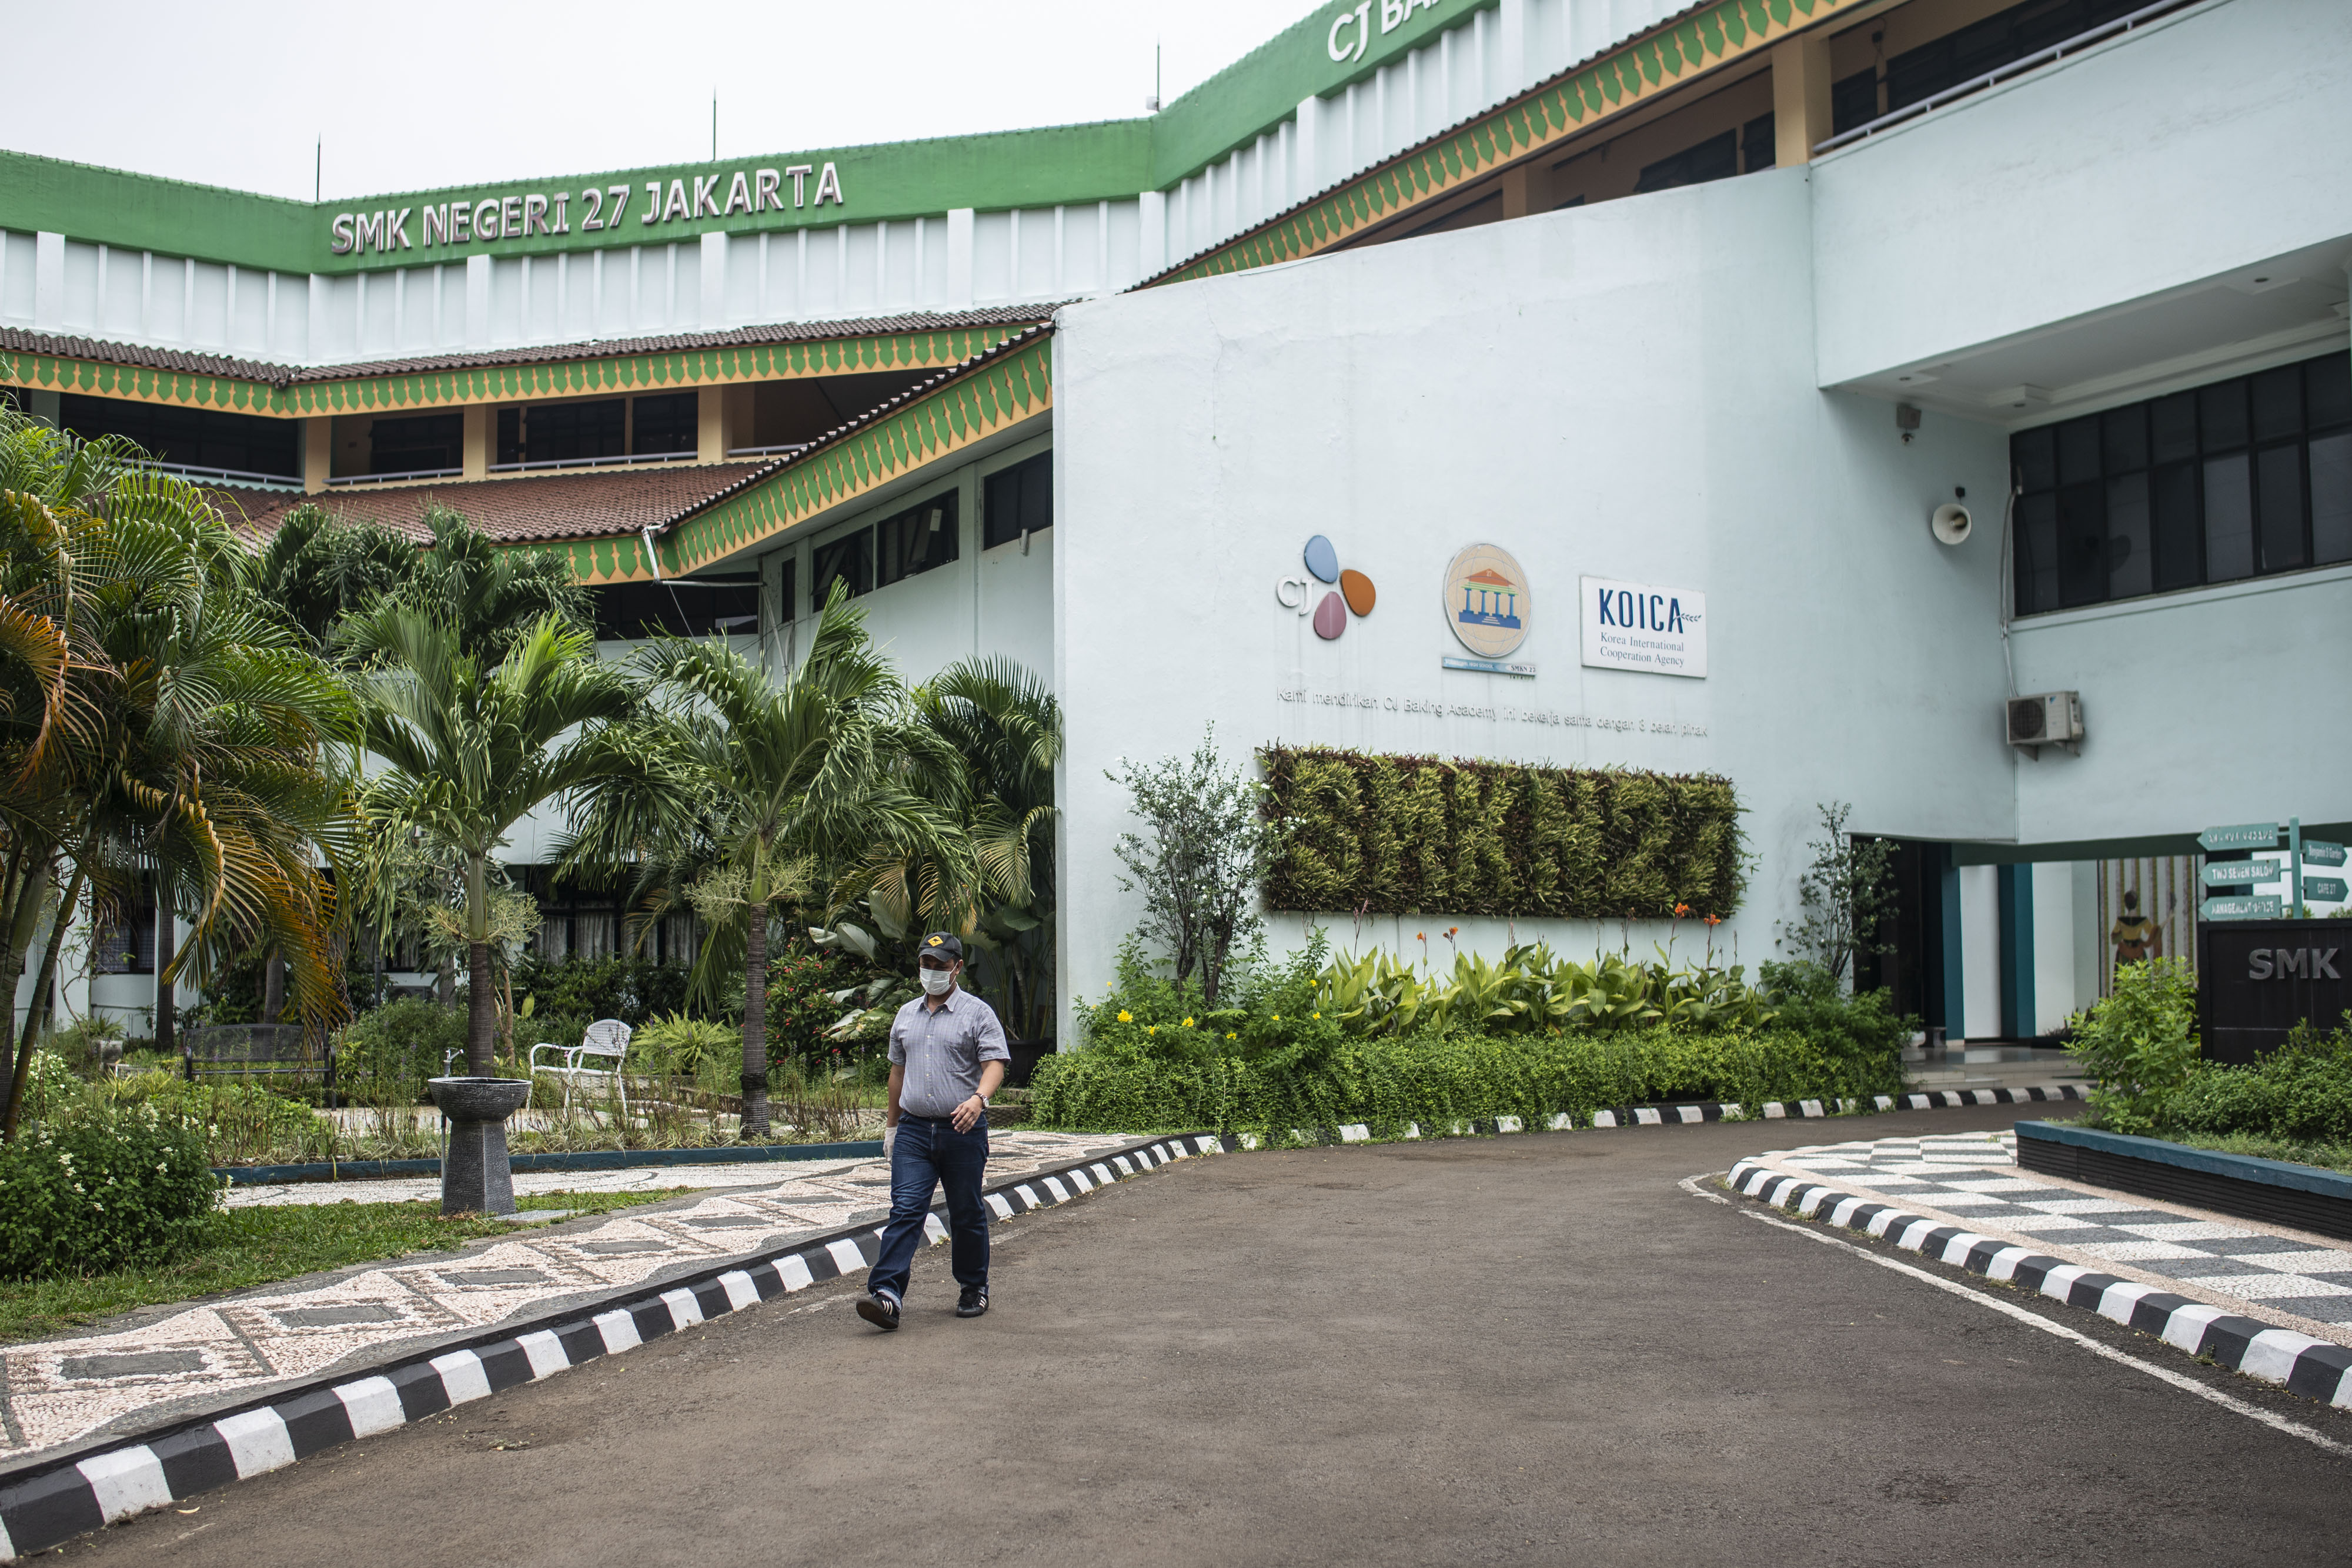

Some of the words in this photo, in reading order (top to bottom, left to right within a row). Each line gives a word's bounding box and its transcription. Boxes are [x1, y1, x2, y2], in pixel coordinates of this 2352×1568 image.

[1327, 0, 1372, 62] CJ
[1381, 0, 1441, 35] BA
[331, 207, 412, 255] SMK
[423, 192, 570, 247] NEGERI
[582, 184, 632, 230] 27
[642, 162, 844, 225] JAKARTA
[1486, 570, 1492, 578] 27
[1276, 574, 1316, 616] CJ
[1599, 587, 1684, 634] KOICA
[1600, 646, 1652, 663] Cooperation
[1654, 654, 1684, 668] Agency
[1601, 631, 1626, 645] Korea
[1630, 636, 1684, 652] International
[1277, 686, 1308, 703] Kami
[1313, 691, 1378, 709] mendirikan
[1383, 696, 1399, 710] CJ
[1404, 697, 1443, 716] Baking
[1447, 703, 1499, 721] Academy
[1521, 708, 1561, 726] bekerja
[2212, 868, 2227, 880] TWO
[2228, 866, 2250, 878] SEVEN
[2251, 865, 2273, 877] SALON
[2317, 882, 2329, 894] CAFE
[2330, 883, 2336, 895] 27
[2249, 948, 2341, 979] SMK
